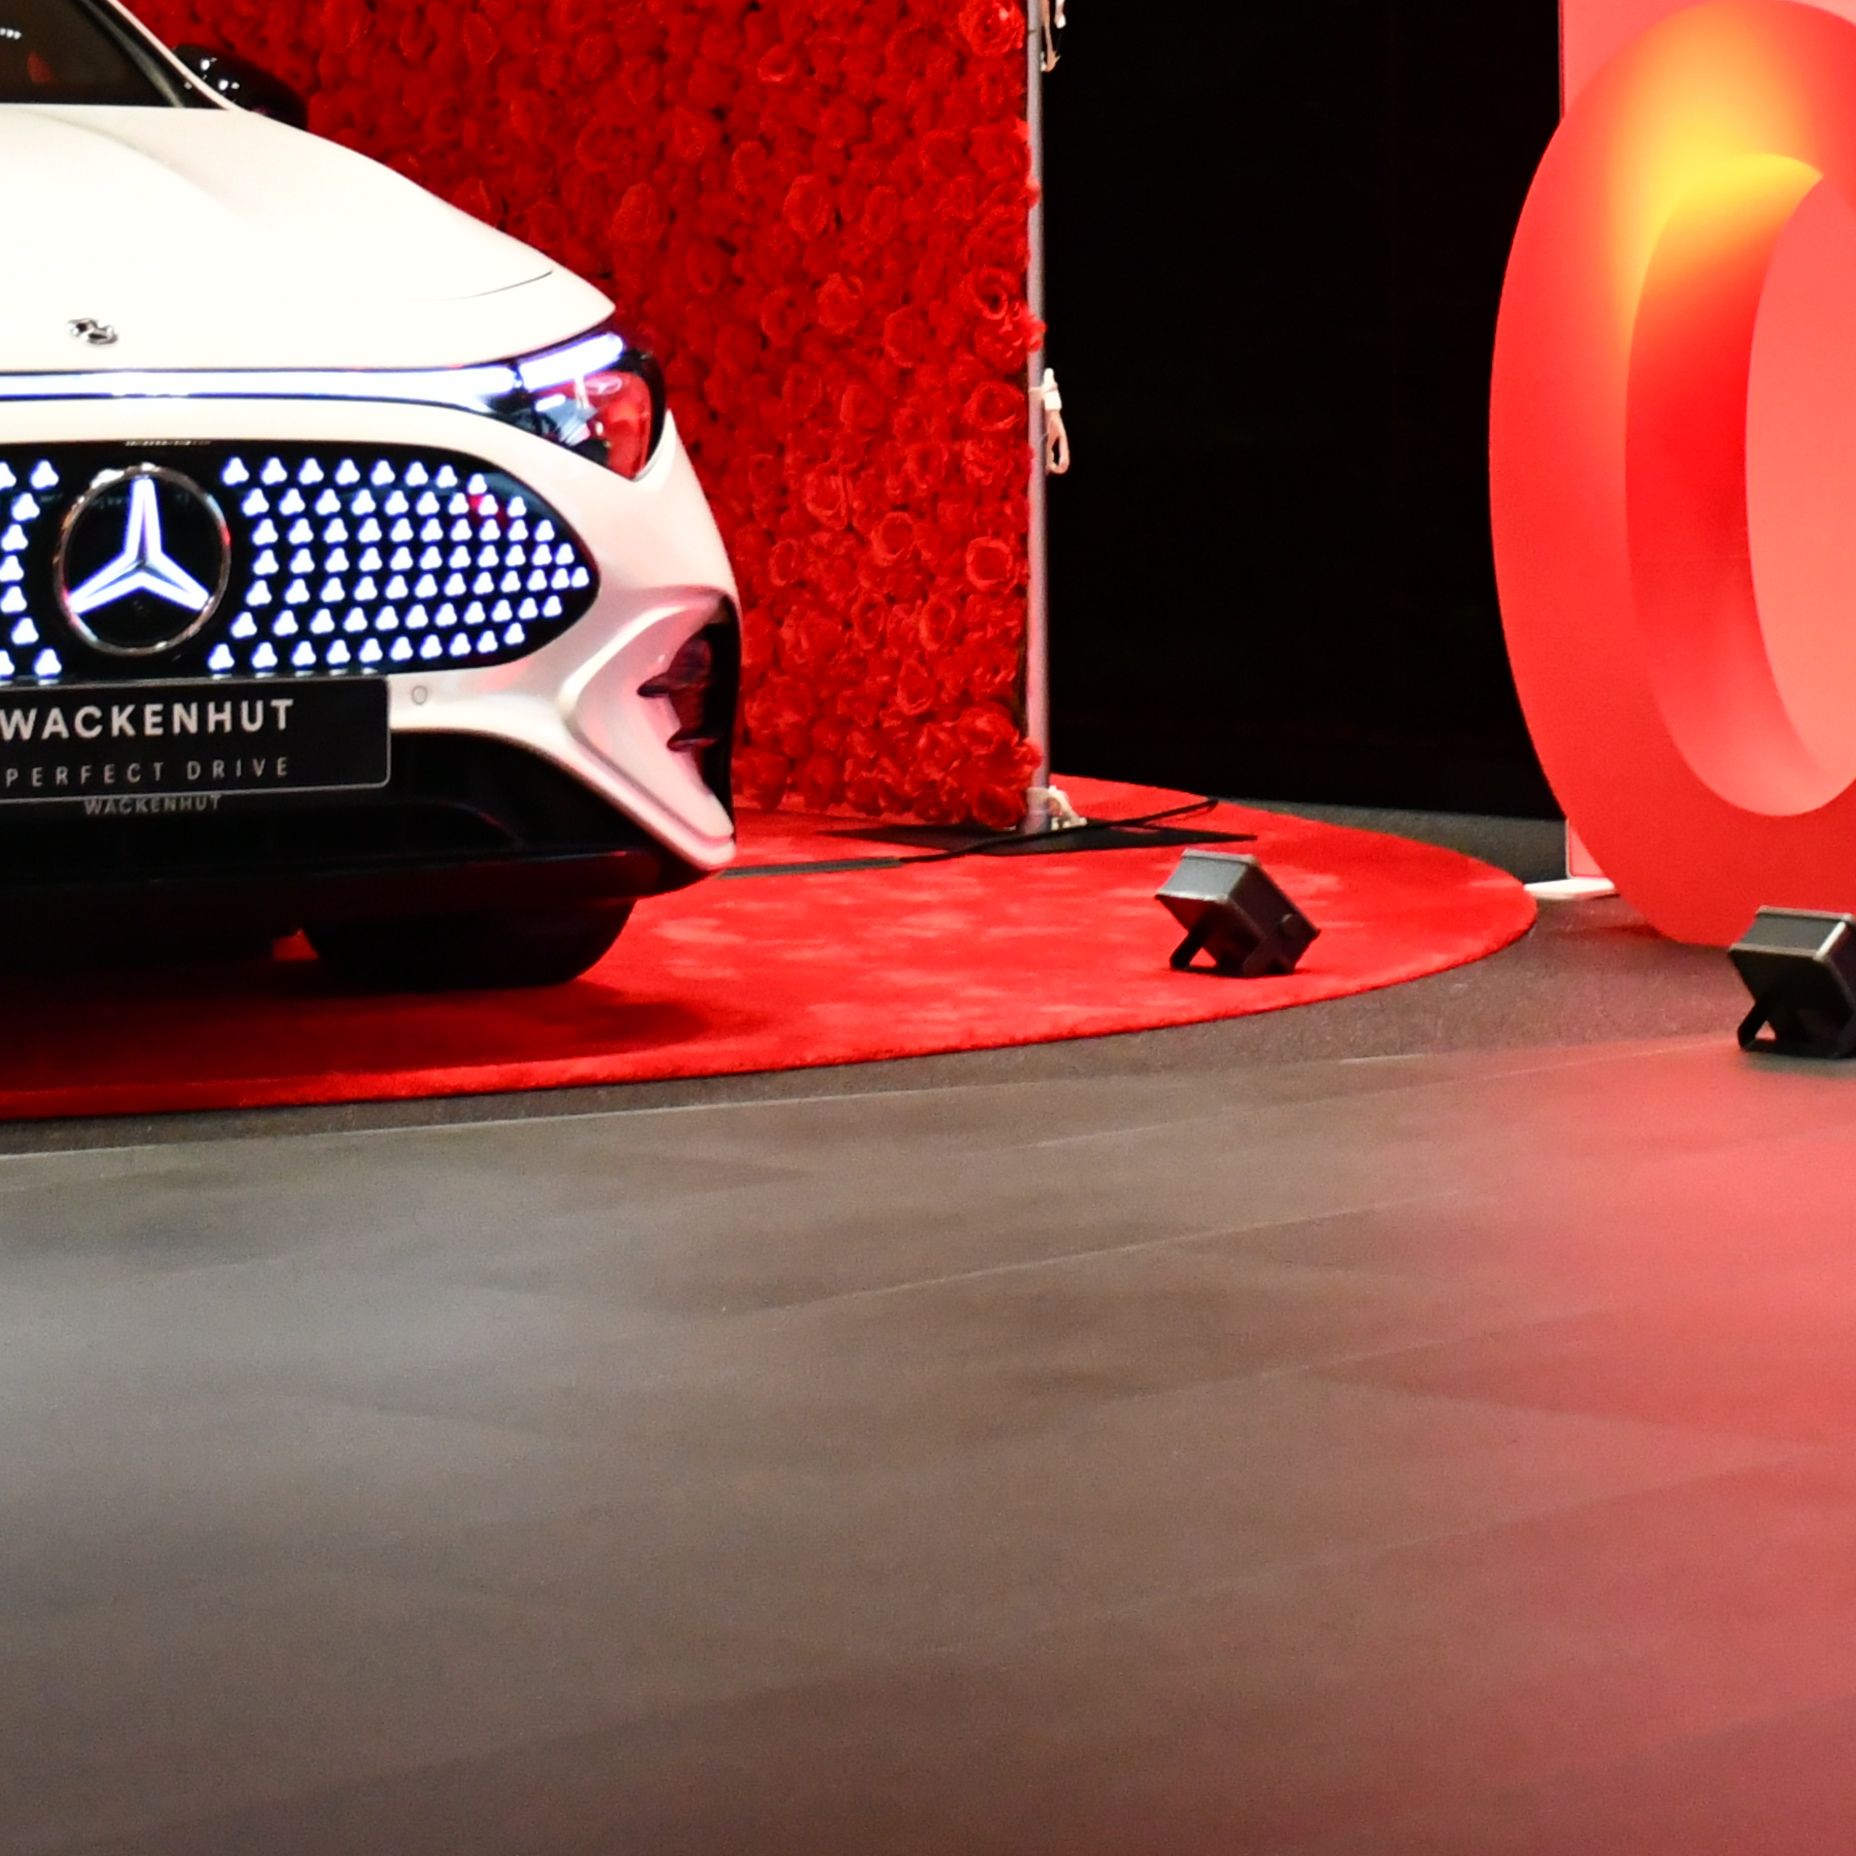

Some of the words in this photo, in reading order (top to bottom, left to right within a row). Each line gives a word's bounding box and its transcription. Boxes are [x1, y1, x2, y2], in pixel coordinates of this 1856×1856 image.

[5, 761, 165, 789] PERFECT
[186, 756, 288, 783] DRIVE
[84, 794, 222, 816] WACKENHUT
